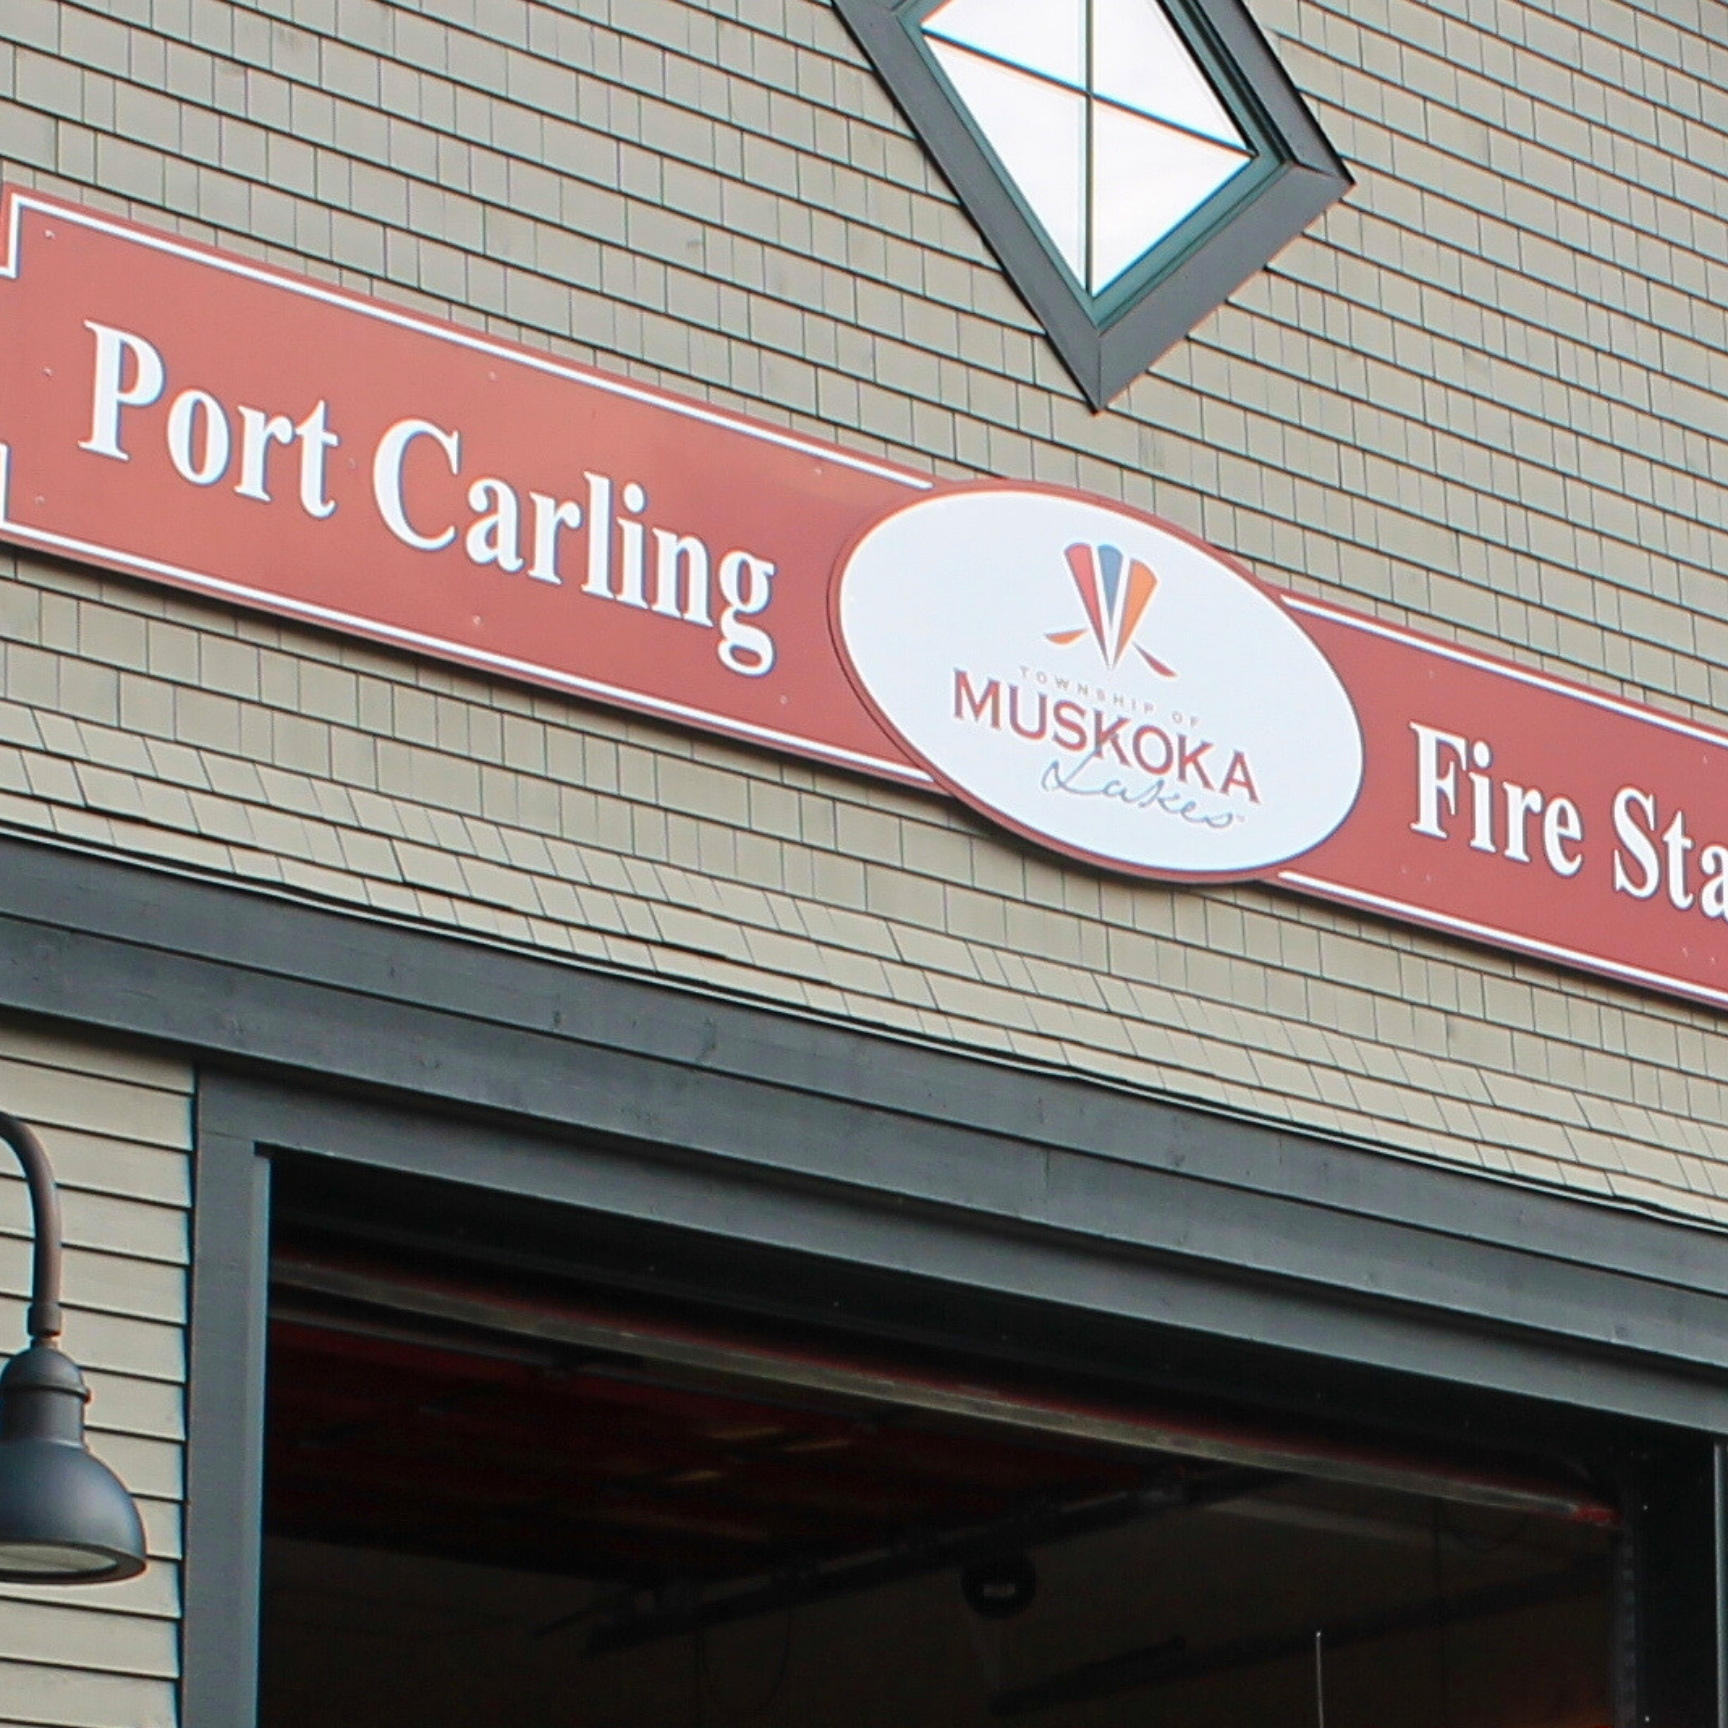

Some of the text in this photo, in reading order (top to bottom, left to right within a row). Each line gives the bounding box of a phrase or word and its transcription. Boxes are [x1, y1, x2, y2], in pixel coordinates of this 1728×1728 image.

[77, 318, 776, 677] Port Carling
[952, 667, 1262, 804] MUSKOKA
[1020, 666, 1200, 728] TOWNSHIP OF
[1041, 748, 1234, 829] Lakes
[1408, 720, 1585, 878] Fire
